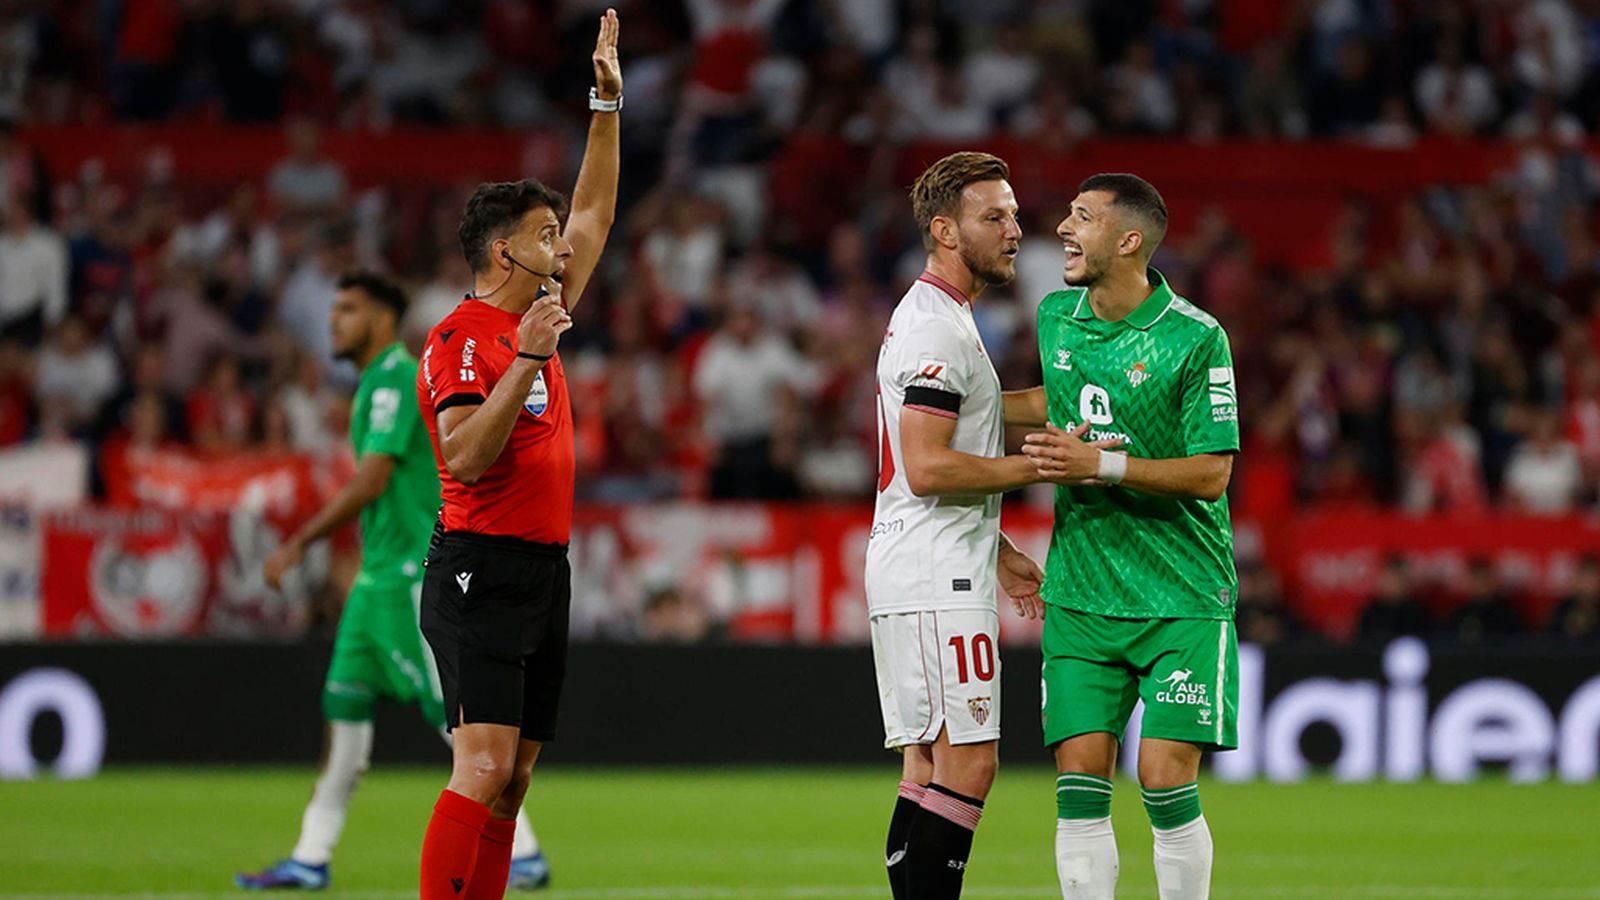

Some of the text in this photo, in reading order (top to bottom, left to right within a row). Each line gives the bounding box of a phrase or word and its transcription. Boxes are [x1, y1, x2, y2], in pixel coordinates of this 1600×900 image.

[948, 633, 995, 684] 10
[1177, 682, 1207, 695] AUS
[1156, 691, 1212, 706] GLOBAL
